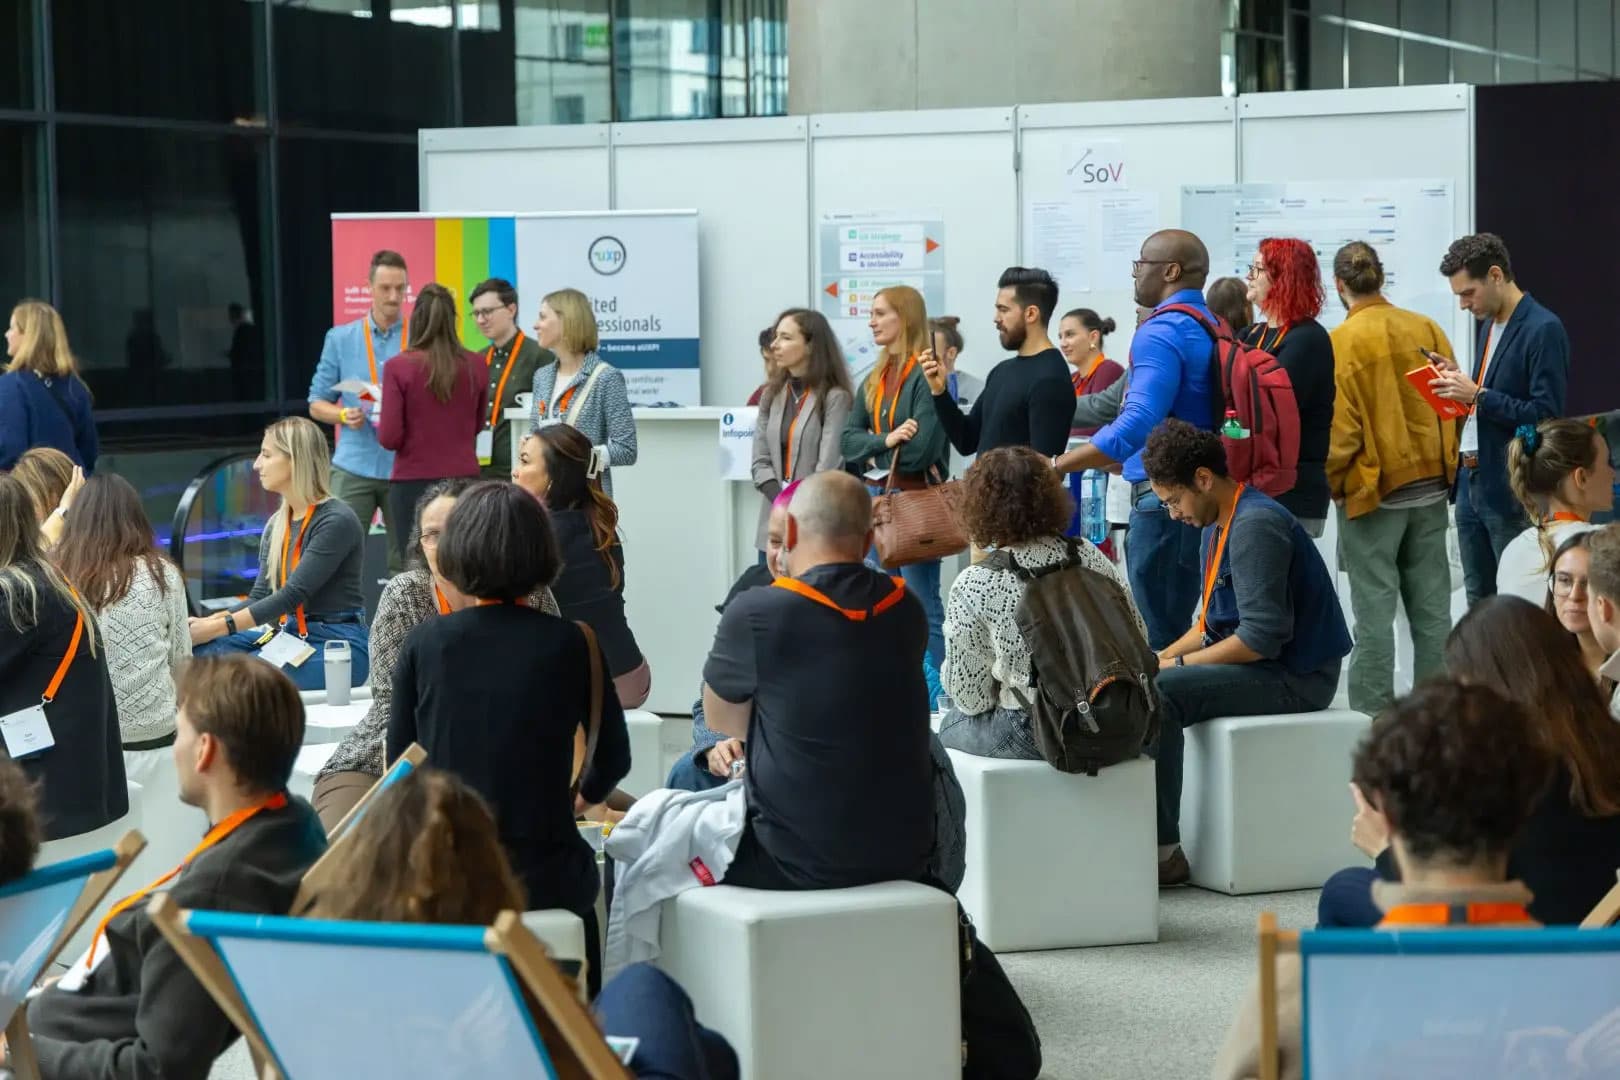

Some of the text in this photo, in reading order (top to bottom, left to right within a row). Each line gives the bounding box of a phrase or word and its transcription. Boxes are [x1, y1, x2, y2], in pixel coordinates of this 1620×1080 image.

[1083, 162, 1123, 183] SoV
[860, 250, 903, 259] Accessibility
[592, 297, 617, 313] ited
[597, 315, 661, 332] essionals
